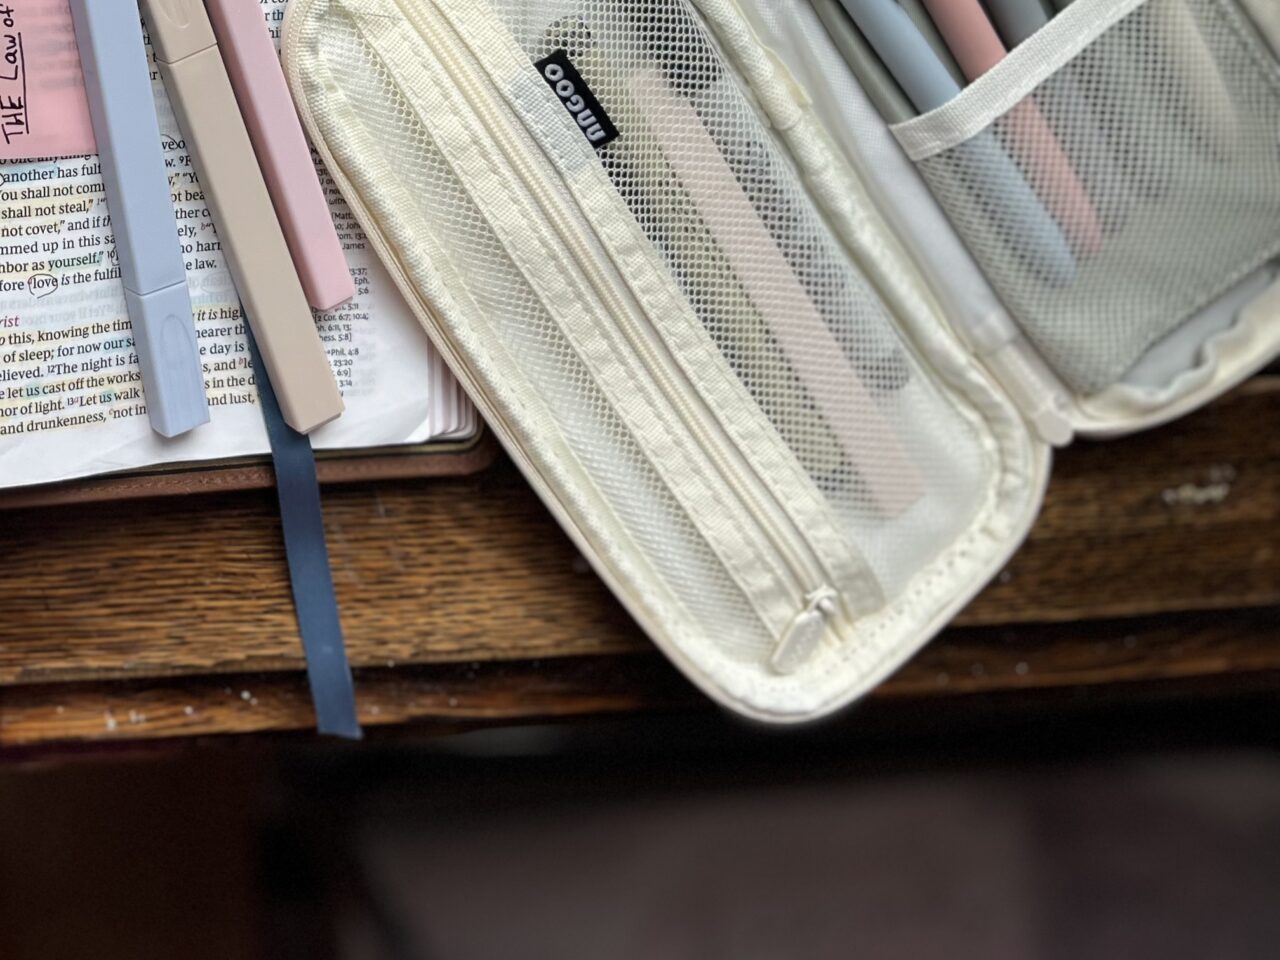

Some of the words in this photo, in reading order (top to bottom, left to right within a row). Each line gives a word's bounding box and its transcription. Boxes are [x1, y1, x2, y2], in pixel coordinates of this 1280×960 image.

[0, 33, 20, 80] Law
[0, 95, 24, 144] THE
[0, 420, 25, 435] and
[27, 412, 106, 433] drunkenness,
